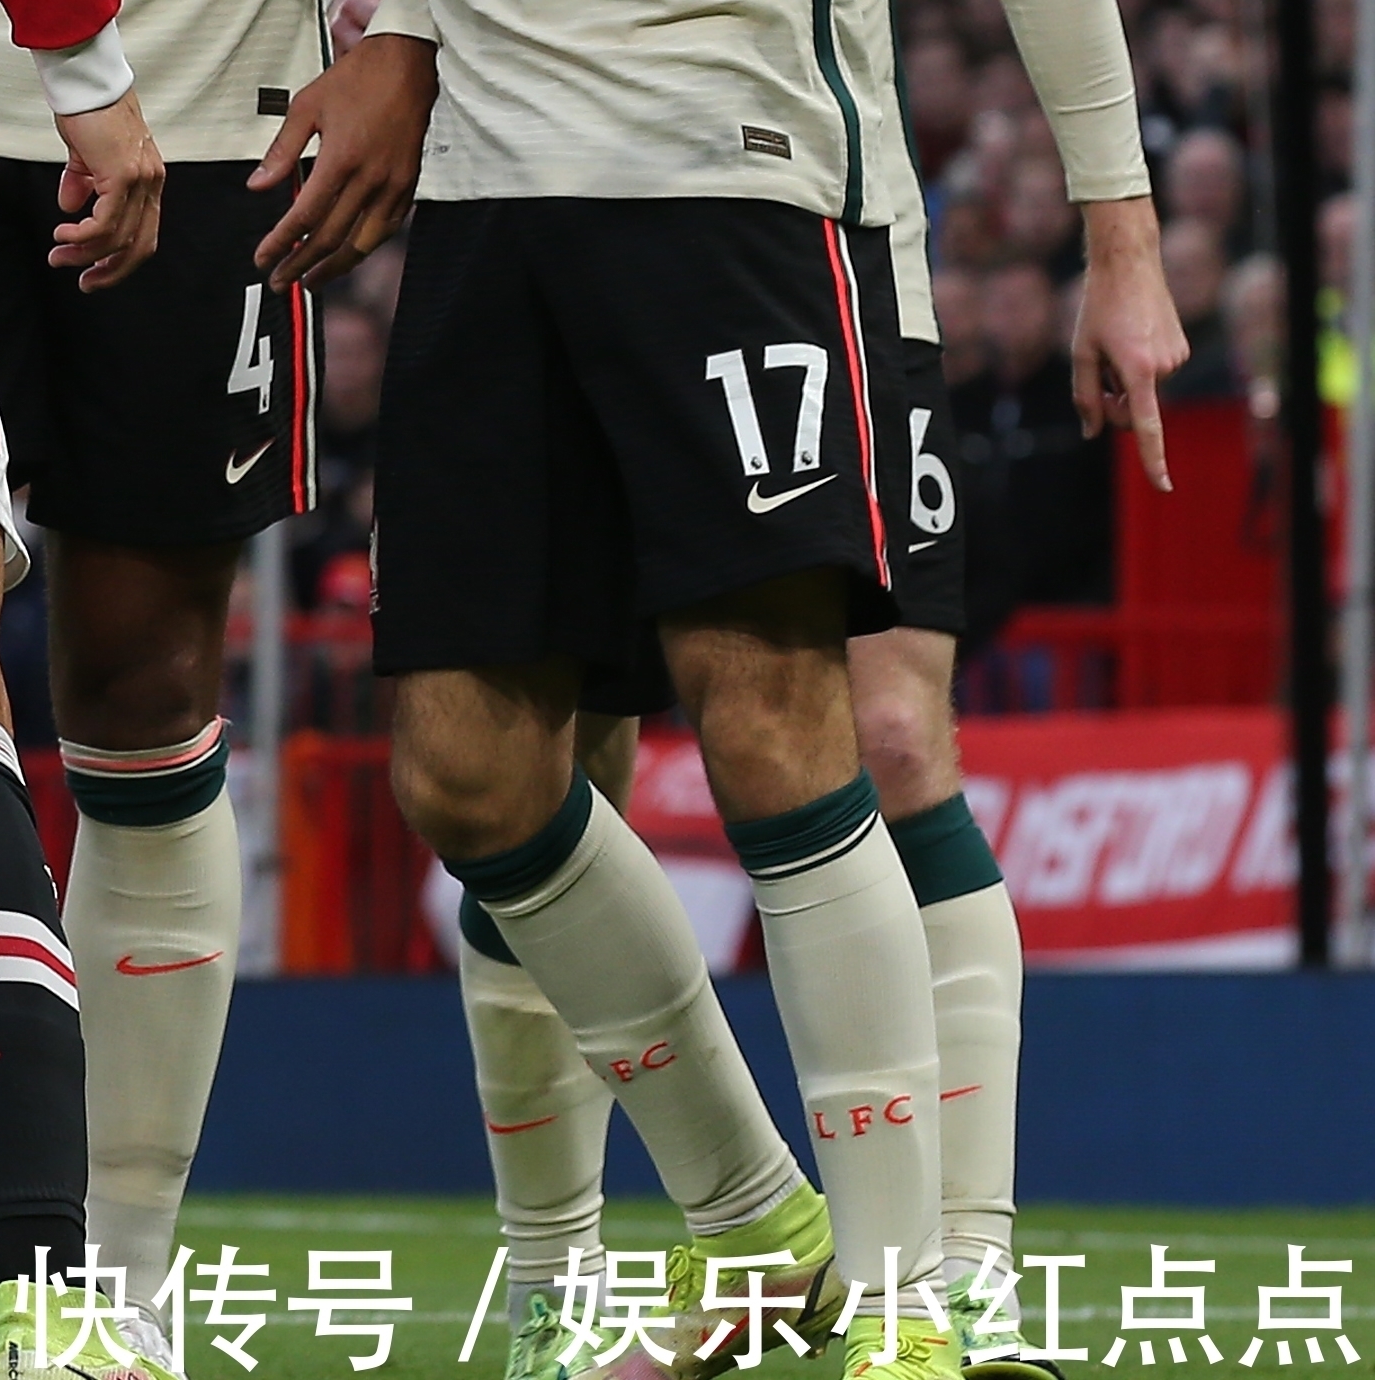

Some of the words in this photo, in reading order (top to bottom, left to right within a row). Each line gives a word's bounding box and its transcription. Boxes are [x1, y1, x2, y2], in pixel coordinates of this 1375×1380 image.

[227, 282, 275, 415] 4
[705, 342, 829, 477] 17
[909, 407, 956, 535] 6
